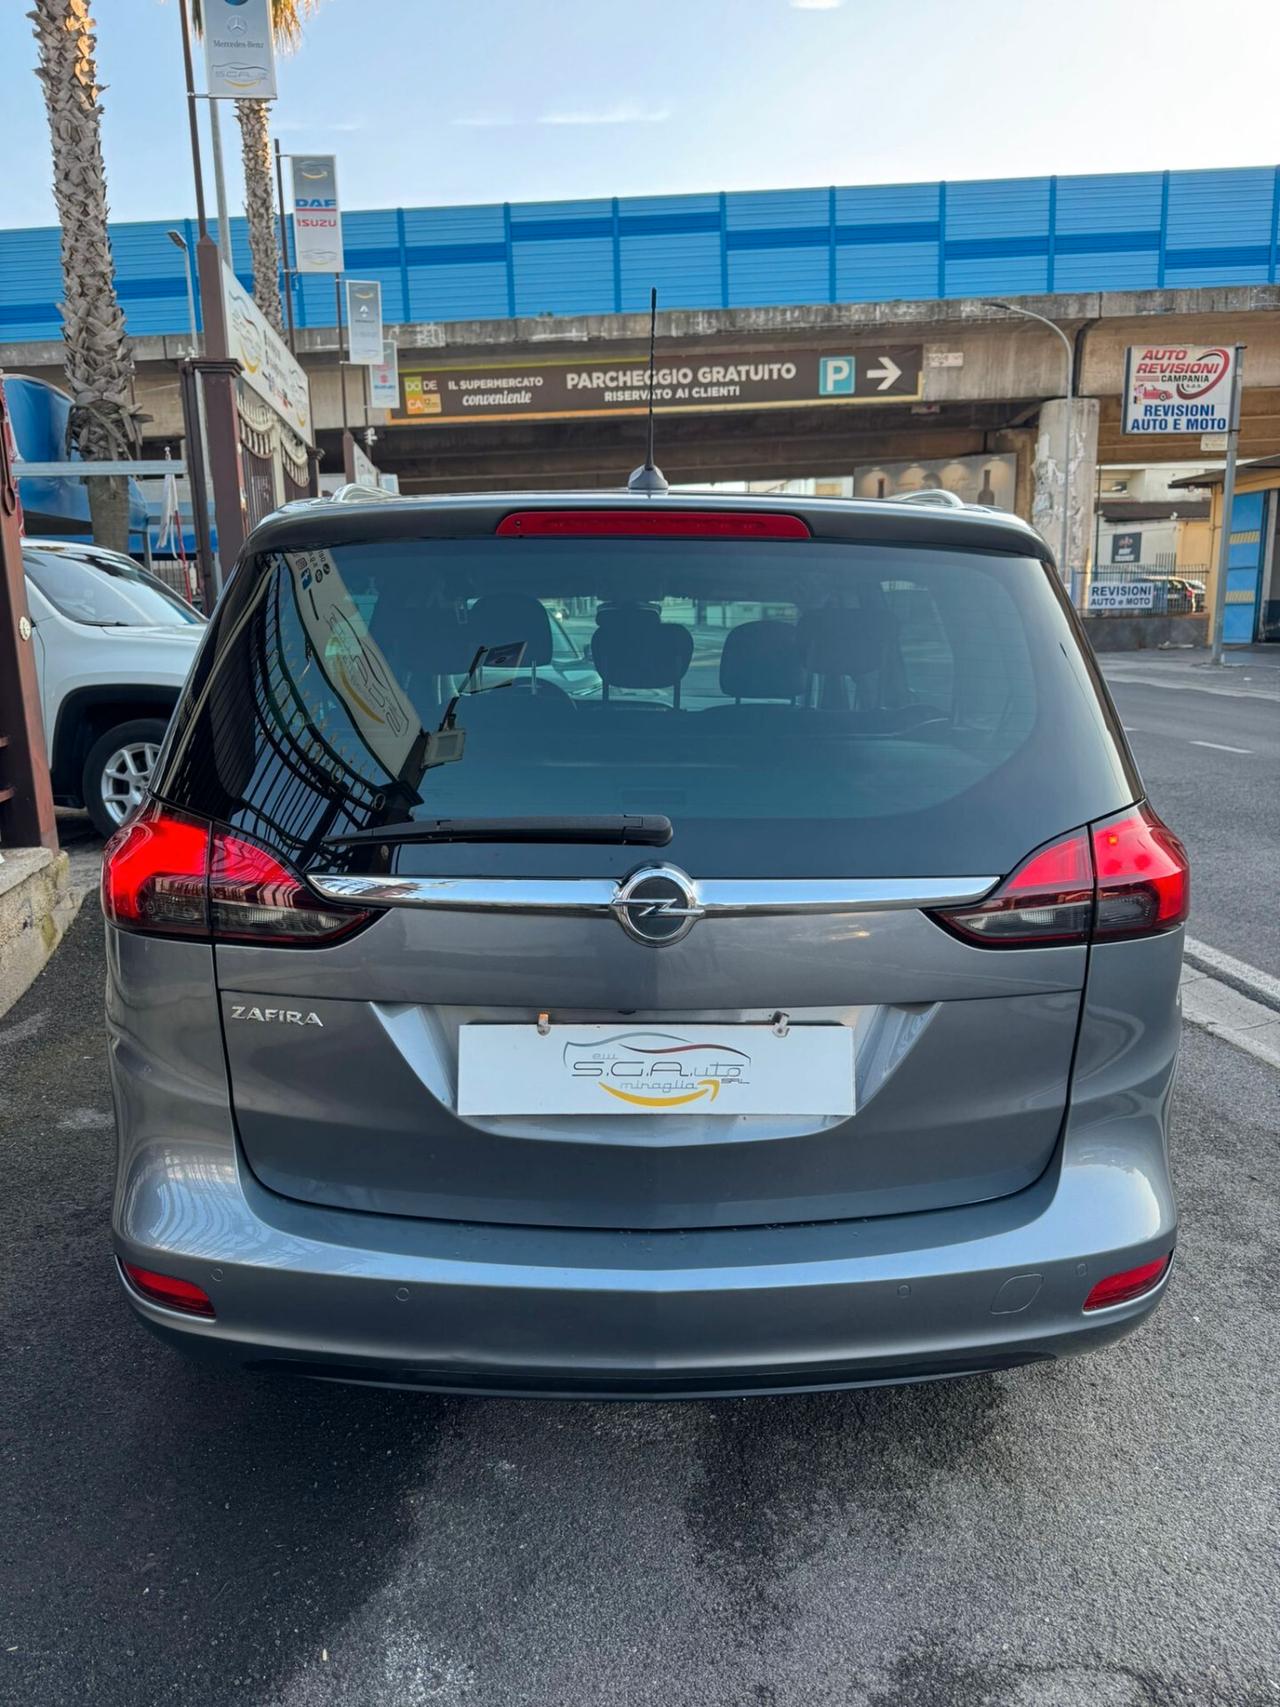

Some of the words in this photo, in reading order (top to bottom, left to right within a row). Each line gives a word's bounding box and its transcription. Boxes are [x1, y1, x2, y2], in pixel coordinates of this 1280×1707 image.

[295, 198, 337, 207] DAF
[297, 219, 337, 227] ISUZU
[1142, 350, 1187, 360] AUTO
[1136, 363, 1220, 374] REVISIONI
[566, 367, 693, 389] PARCHEGGIO
[697, 363, 797, 384] GRATUITO
[826, 360, 850, 392] P
[448, 381, 458, 390] IL
[460, 377, 543, 390] SUPERMERCATO
[462, 390, 532, 406] conveniente
[604, 388, 672, 402] RISERVATO
[675, 387, 689, 398] AI
[692, 386, 740, 398] CLIENTI
[1144, 404, 1215, 417] REVISIONI
[1131, 419, 1168, 431] AUTO
[1173, 419, 1182, 430] E
[1186, 418, 1226, 430] MOTO
[1091, 586, 1152, 596] REVISIONI
[1091, 597, 1116, 606] AUTO
[1126, 597, 1151, 606] MOTO
[231, 1006, 324, 1027] ZAFIRA
